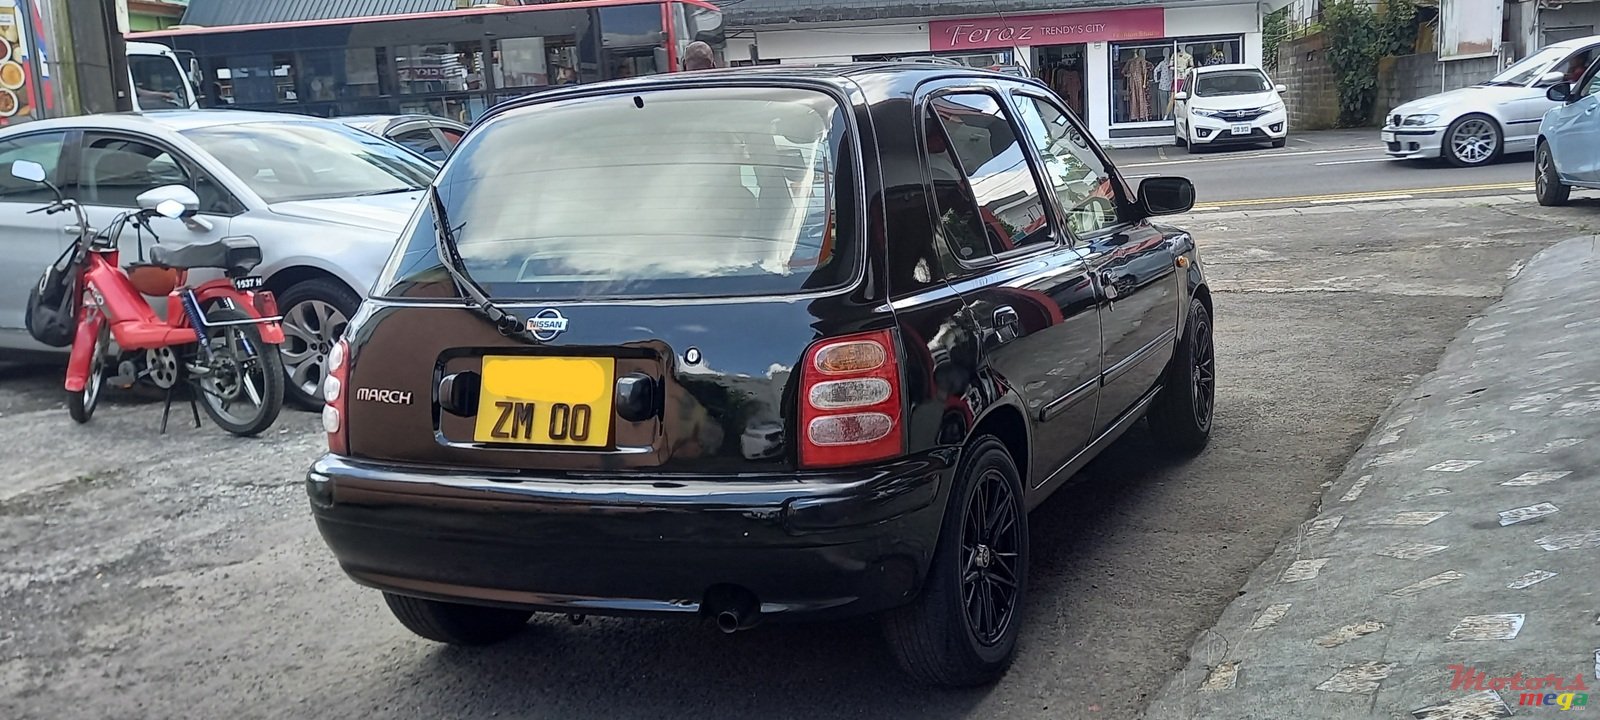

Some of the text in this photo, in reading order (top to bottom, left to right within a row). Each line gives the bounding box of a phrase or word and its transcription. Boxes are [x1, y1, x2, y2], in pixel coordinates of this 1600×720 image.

[945, 23, 1106, 46] Feroz TRENDY'S CITY
[528, 320, 562, 329] NISSAN
[356, 387, 412, 405] MARCH
[490, 401, 535, 439] ZM
